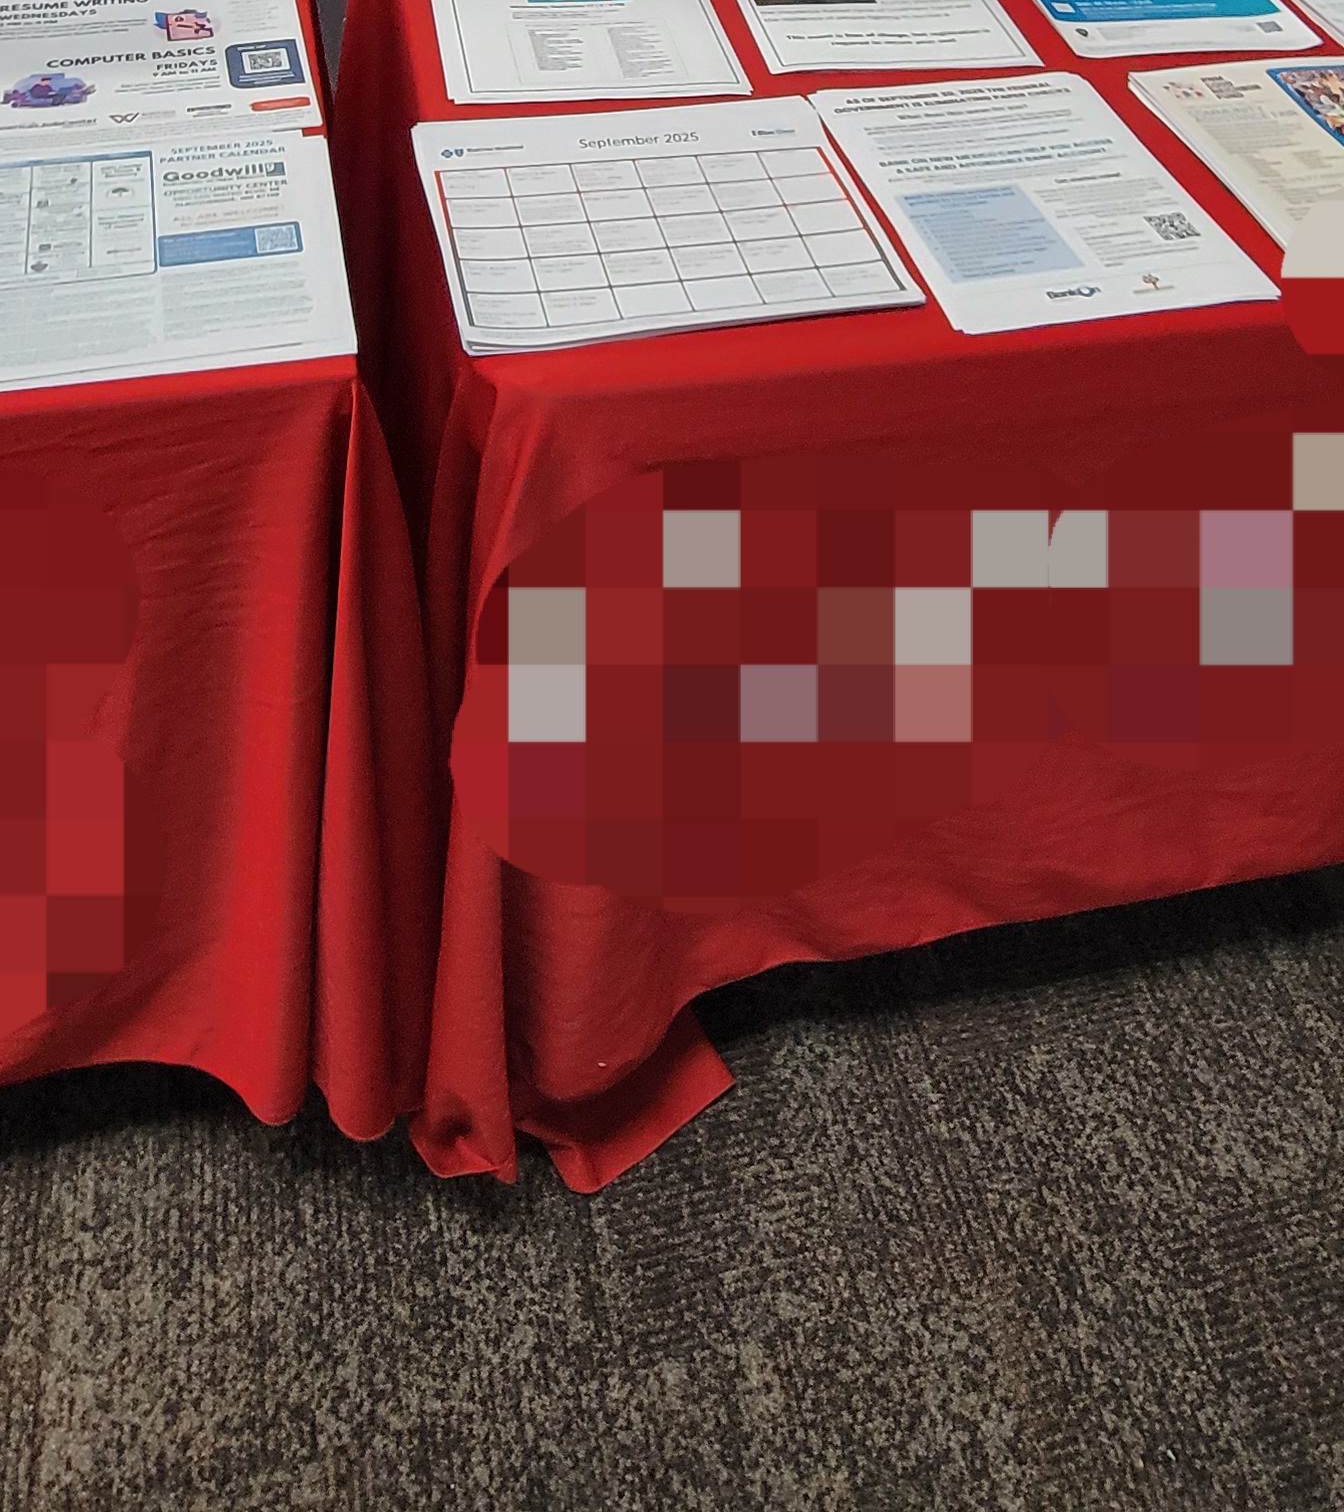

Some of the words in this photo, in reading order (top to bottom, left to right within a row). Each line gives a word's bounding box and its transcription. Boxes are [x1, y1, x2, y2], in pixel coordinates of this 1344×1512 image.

[0, 1, 68, 12] RESUME
[0, 9, 97, 21] WEDNESDAYS
[46, 53, 146, 68] COMPUTER
[152, 46, 216, 59] BASICS
[156, 59, 218, 71] FRIDAYS
[171, 143, 241, 154] SEPTEMBER
[245, 139, 274, 149] 2025
[579, 136, 660, 150] September
[663, 131, 700, 144] 2025
[159, 153, 216, 164] PARTNER
[219, 146, 286, 158] CALENDAR
[163, 163, 264, 182] Goodwill
[246, 179, 288, 188] CENTER
